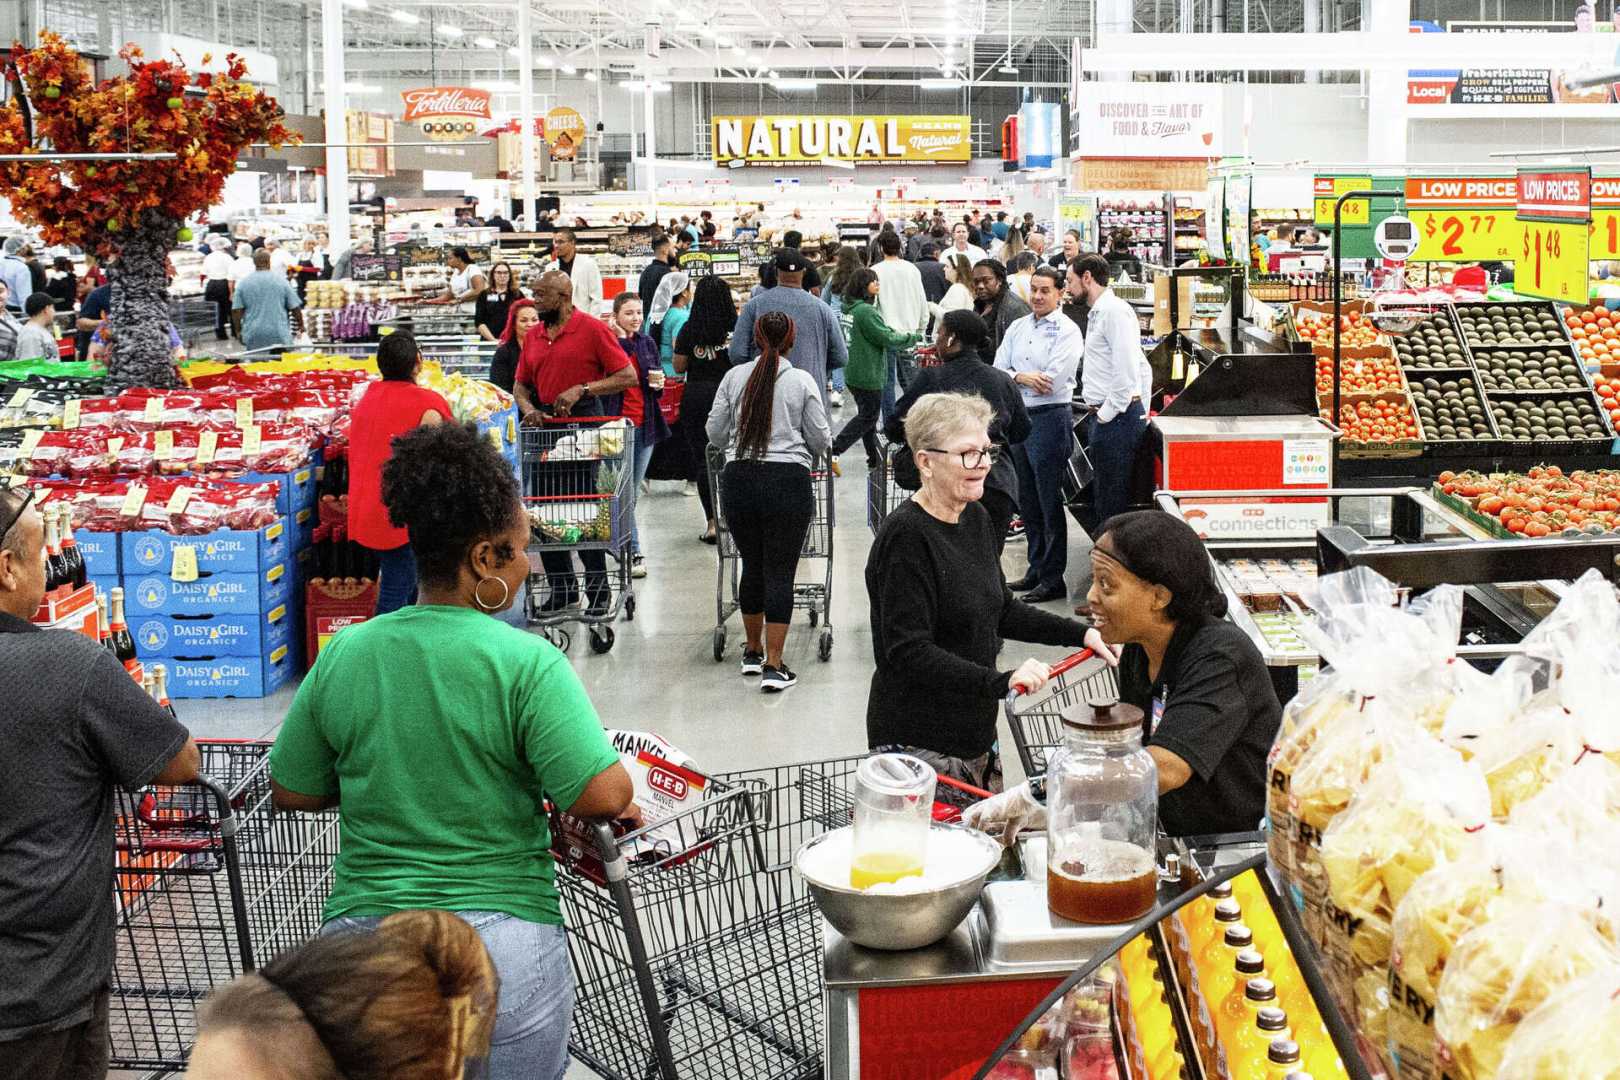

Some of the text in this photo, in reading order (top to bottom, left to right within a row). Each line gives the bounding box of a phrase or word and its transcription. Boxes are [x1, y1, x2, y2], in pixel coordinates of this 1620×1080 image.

[1413, 86, 1446, 97] Local
[406, 89, 486, 116] Tortilleria
[1100, 103, 1149, 118] DISCOVER
[1169, 103, 1188, 117] ART
[1191, 103, 1203, 117] OF
[1113, 121, 1191, 137] FOOD & Flavor
[717, 119, 906, 157] NATURAL
[909, 134, 961, 149] Natural
[1421, 183, 1463, 197] LOW
[1524, 180, 1580, 201] LOW PRICES
[1209, 516, 1318, 532] connections
[214, 539, 246, 552] GIRL
[198, 553, 234, 561] ANICS
[172, 581, 247, 595] DAISY GIRL
[183, 596, 236, 604] ORGANICS
[332, 618, 353, 626] LOW
[174, 623, 248, 637] DAISY GIRL
[185, 638, 237, 646] ORGANICS
[175, 665, 249, 678] DAISY GIRL
[186, 679, 240, 687] ORGANICS
